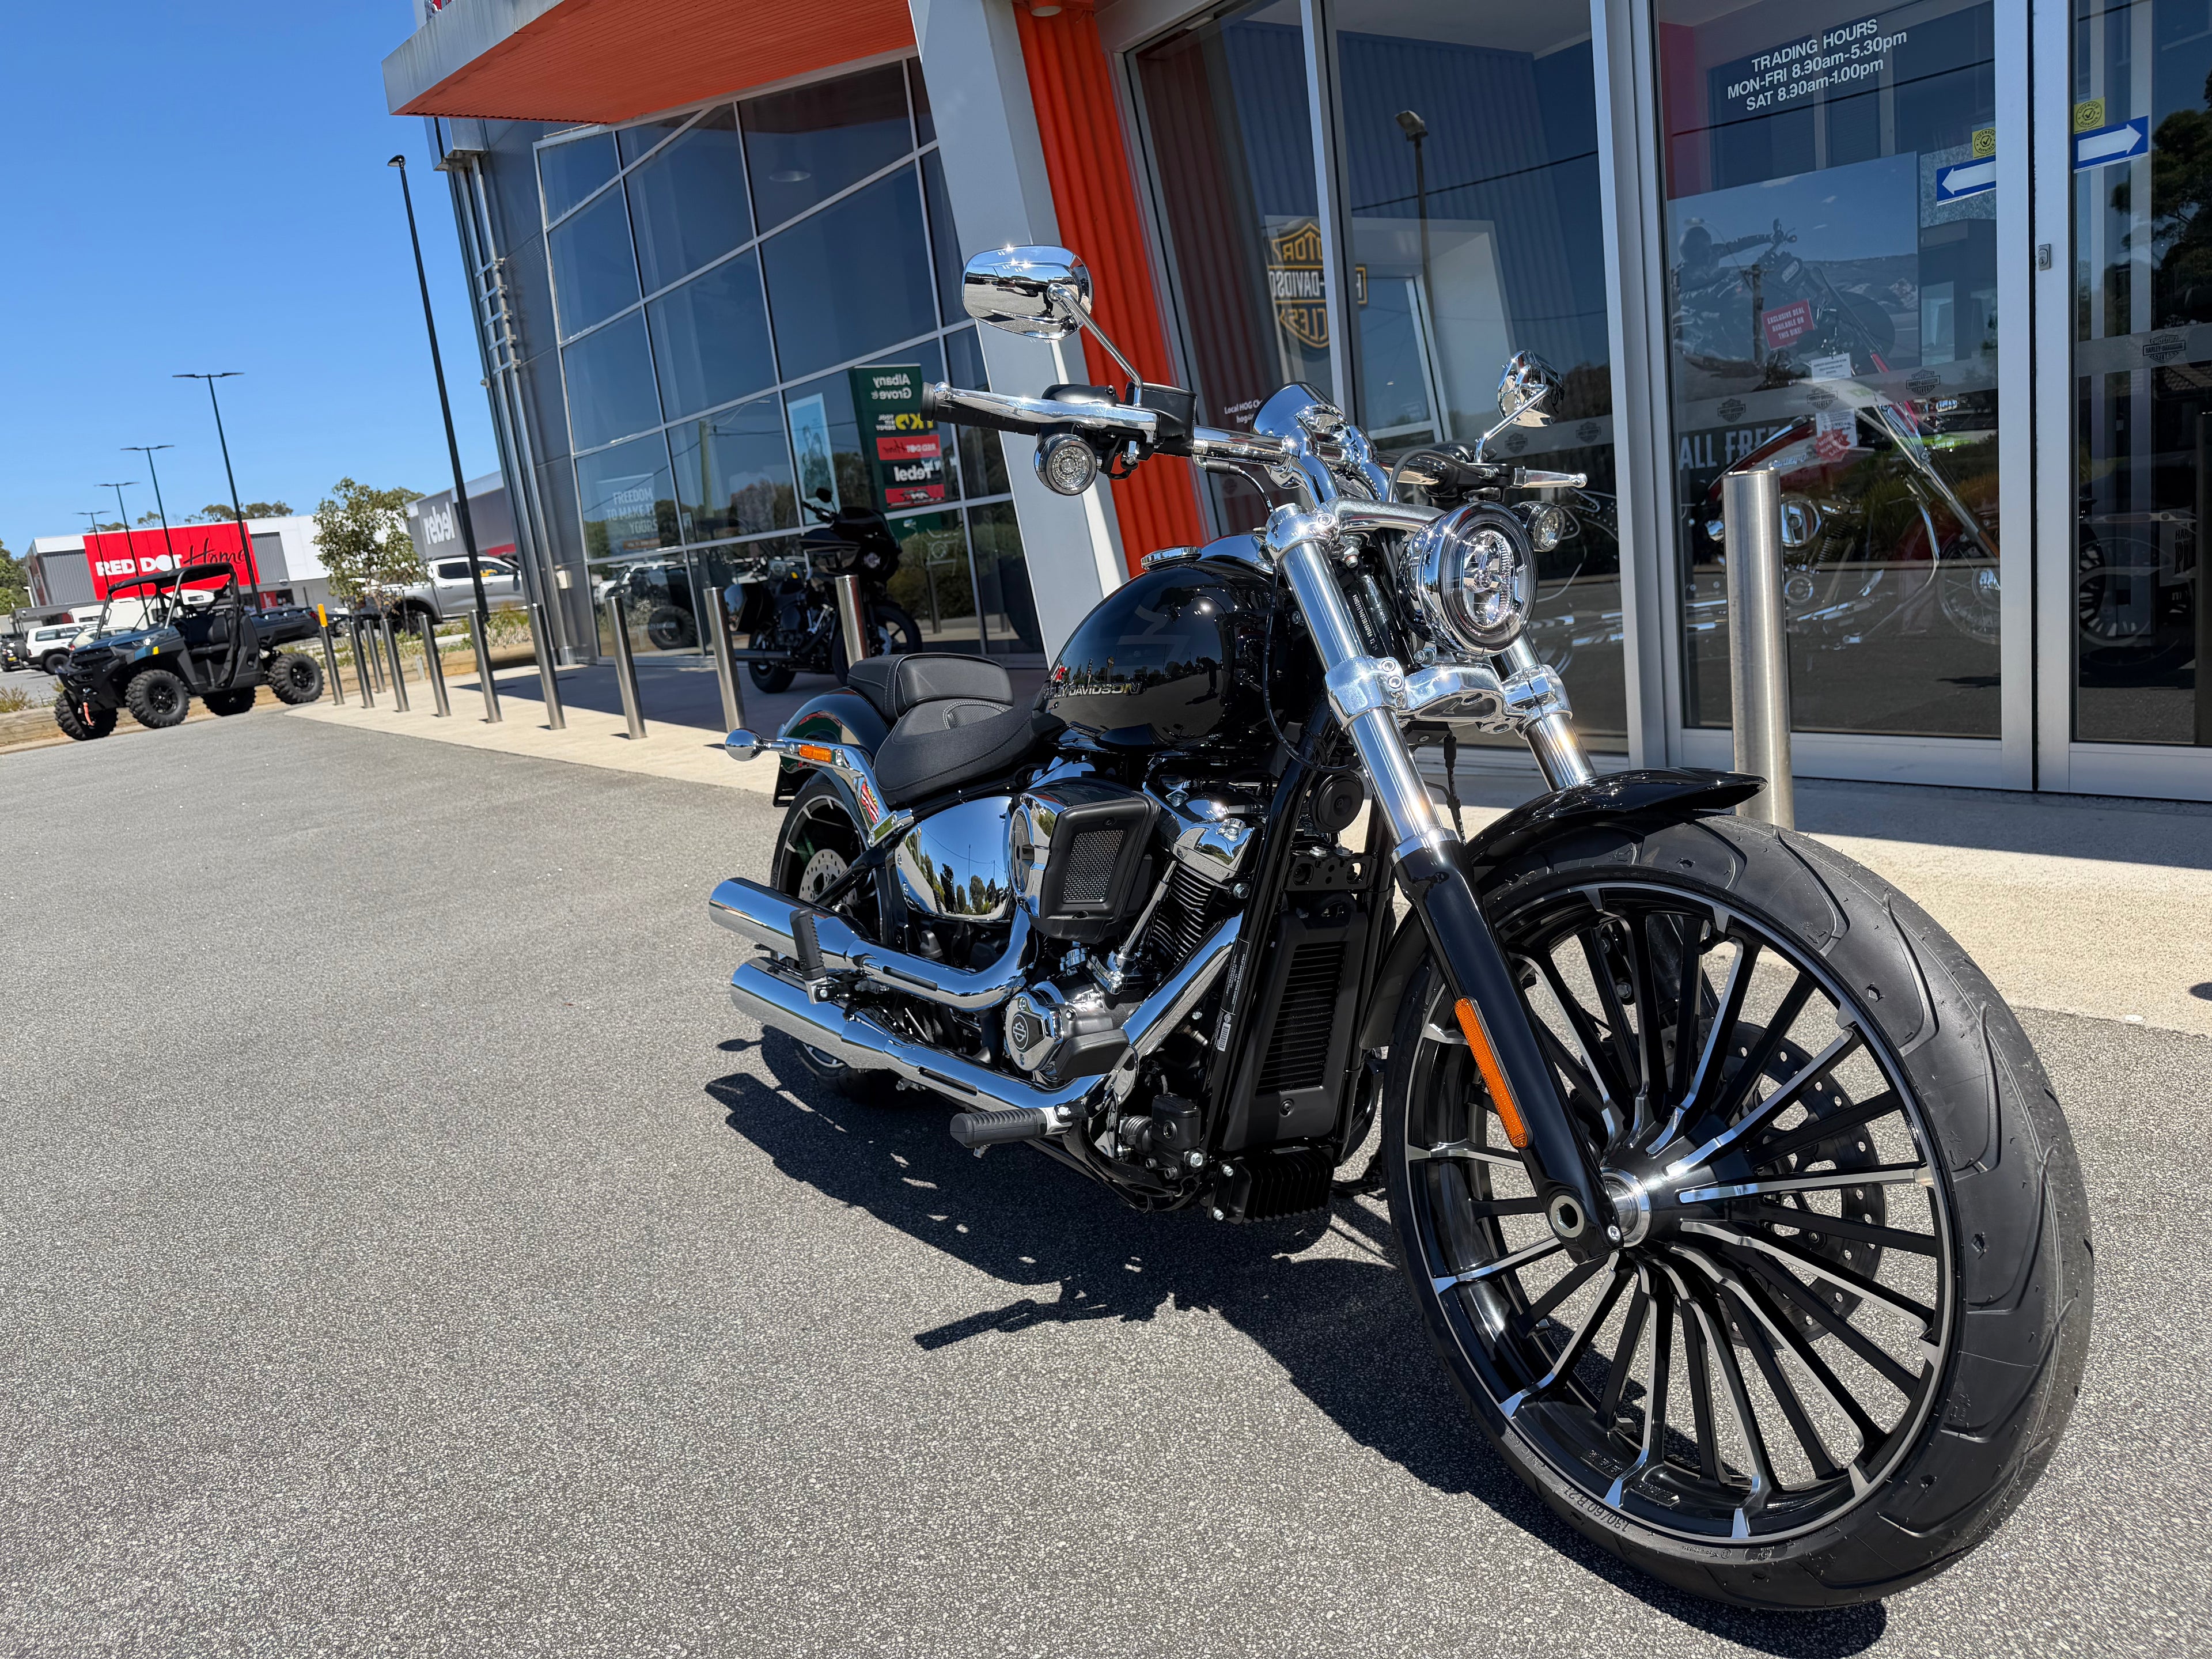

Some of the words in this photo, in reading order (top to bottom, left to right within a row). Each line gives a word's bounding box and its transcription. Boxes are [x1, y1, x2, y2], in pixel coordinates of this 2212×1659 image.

[1751, 39, 1817, 72] TRADING
[1823, 18, 1878, 49] HOURS
[1728, 67, 1787, 100] MON-FRI
[1791, 31, 1907, 78] 8.30am-5.30pm
[1746, 90, 1773, 111] SAT
[1778, 59, 1884, 101] 8.30am-1.00pm
[1767, 310, 1791, 325] EXCLUSIVE
[1792, 306, 1805, 316] DEAL
[1772, 319, 1797, 332] AVAILABLE
[1797, 316, 1804, 325] ON
[1778, 331, 1789, 339] THIS
[1790, 327, 1802, 336] BIKE!
[1224, 403, 1239, 414] Local
[1239, 400, 1253, 411] HOG
[1679, 434, 1718, 470] ALL
[613, 487, 654, 505] FREEDOM
[423, 501, 456, 545] rebel
[606, 509, 617, 521] TO
[619, 505, 644, 520] MAKE
[628, 518, 658, 534] YOURS
[95, 559, 136, 576] RED
[140, 554, 183, 572] DOT
[1587, 1503, 1631, 1532] 130/60
